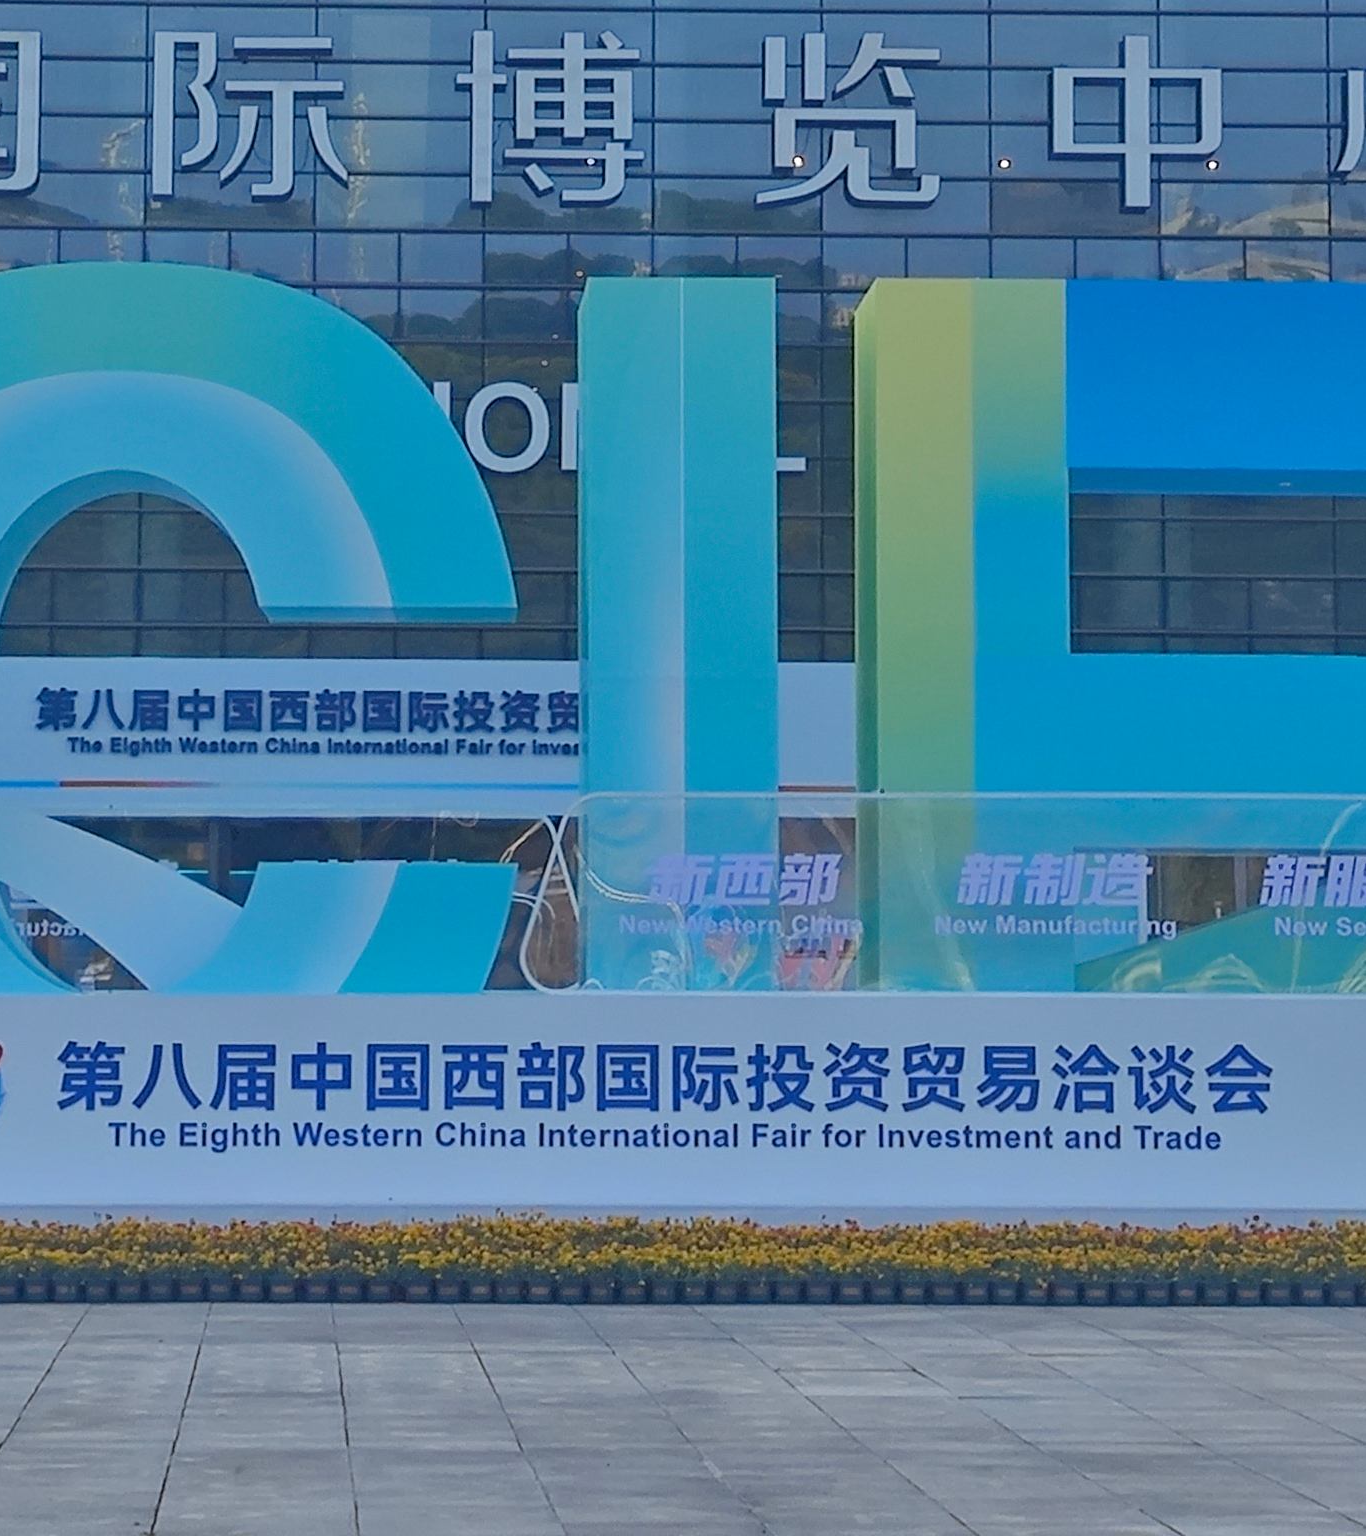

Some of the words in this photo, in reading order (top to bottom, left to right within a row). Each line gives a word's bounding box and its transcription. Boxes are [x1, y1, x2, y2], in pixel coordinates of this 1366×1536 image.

[35, 686, 579, 733] 第八届中国西部国际投资贸
[68, 736, 102, 753] The
[110, 736, 171, 757] Eighth
[178, 737, 258, 754] Western
[265, 737, 320, 754] China
[327, 738, 449, 756] International
[456, 739, 492, 756] Fair
[498, 739, 526, 756] for
[647, 853, 843, 906] 新西部
[957, 852, 1153, 906] 新制造
[619, 916, 669, 935] New
[936, 915, 987, 935] New
[1275, 917, 1327, 936] New
[56, 1040, 1274, 1114] 第八届中国西部国际投资贸易洽谈会
[108, 1122, 166, 1147] The
[179, 1122, 281, 1153] Eighth
[292, 1122, 422, 1147] Western
[435, 1121, 526, 1148] China
[538, 1121, 738, 1148] International
[751, 1122, 813, 1148] Fair
[821, 1121, 867, 1149] for
[878, 1123, 1053, 1149] Investment
[1064, 1124, 1122, 1150] and
[1134, 1124, 1222, 1151] Trade
